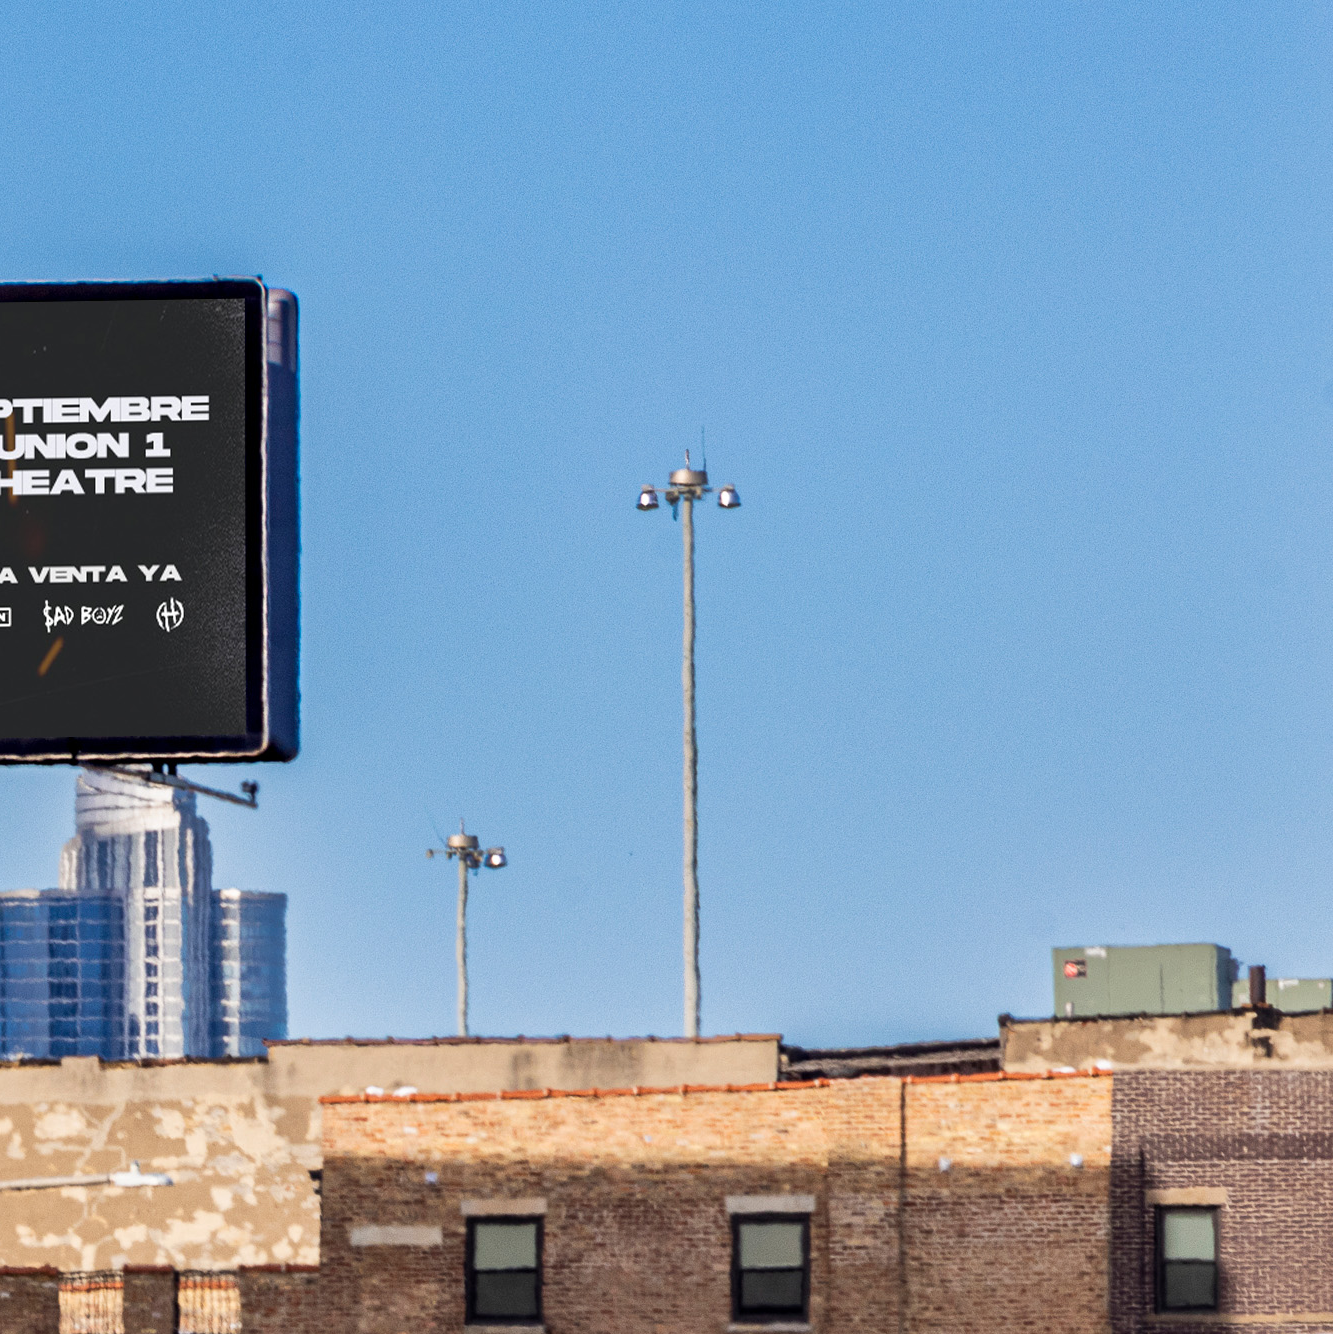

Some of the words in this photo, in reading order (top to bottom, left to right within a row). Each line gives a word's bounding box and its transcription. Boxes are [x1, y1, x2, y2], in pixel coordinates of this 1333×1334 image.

[145, 432, 171, 458] 1
[29, 565, 128, 584] VENTA
[138, 564, 182, 582] YA
